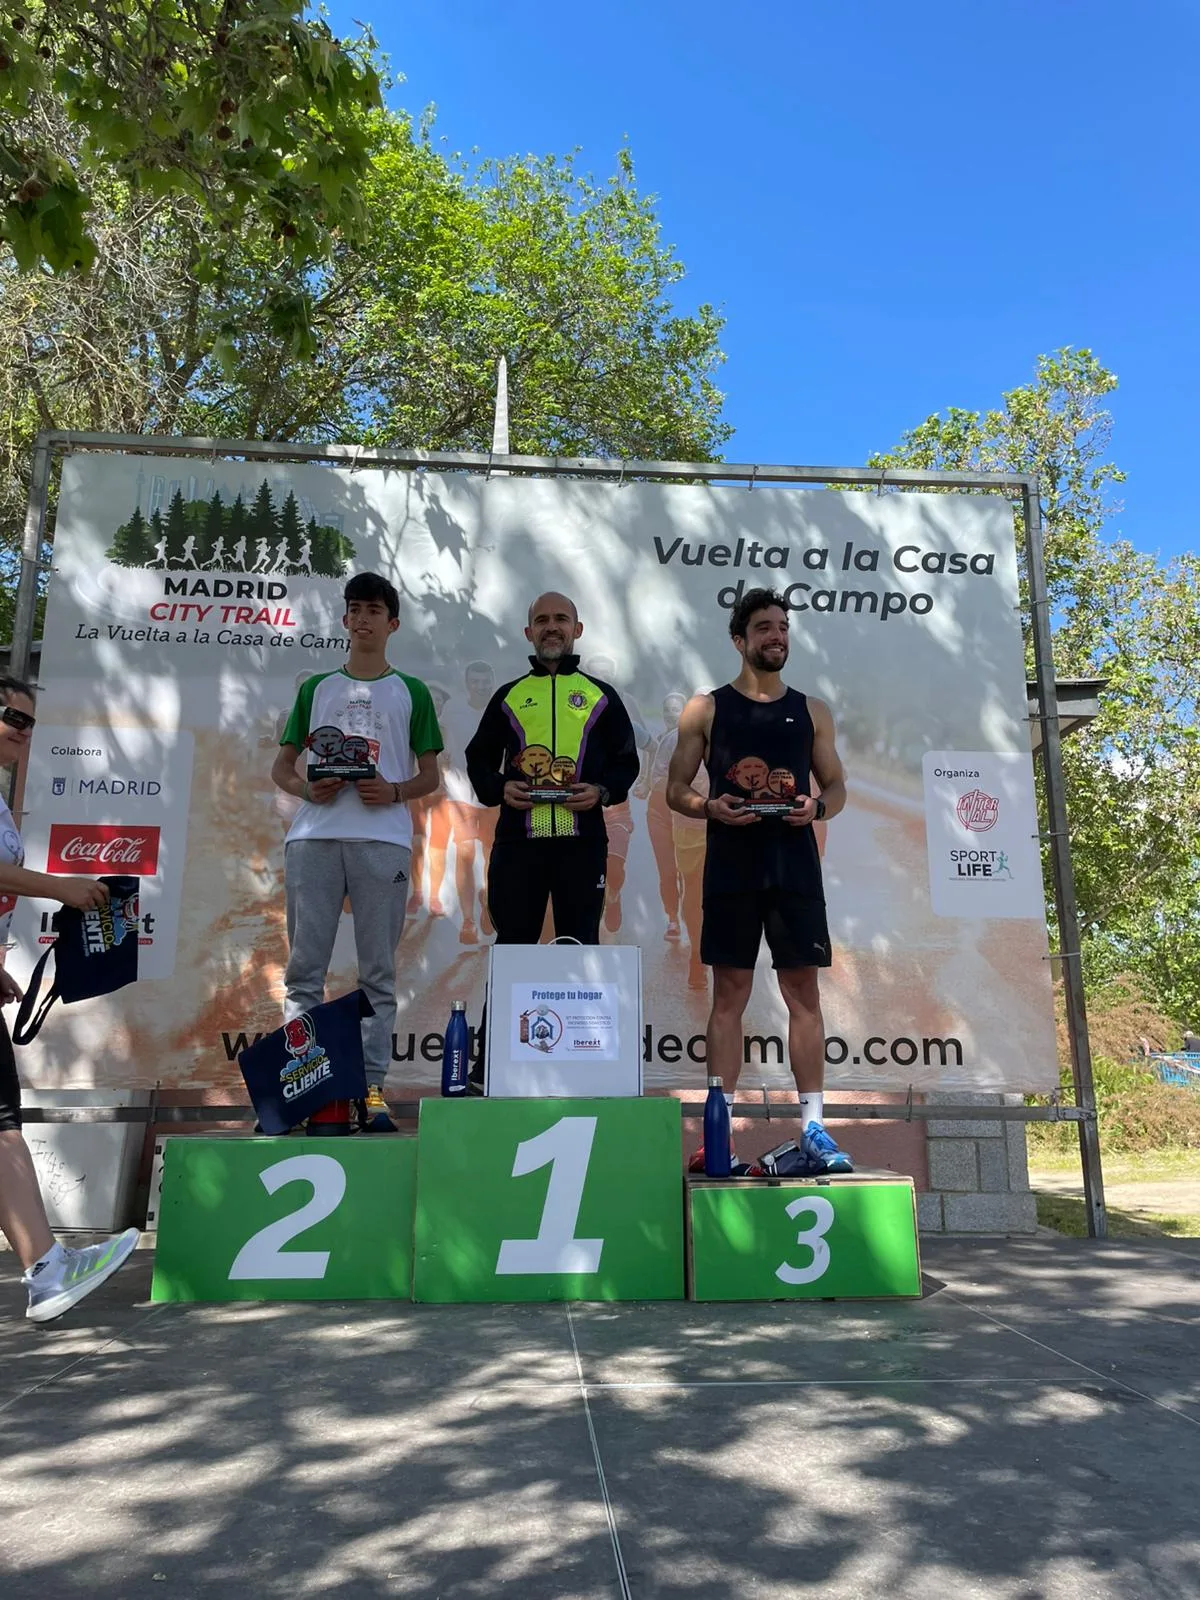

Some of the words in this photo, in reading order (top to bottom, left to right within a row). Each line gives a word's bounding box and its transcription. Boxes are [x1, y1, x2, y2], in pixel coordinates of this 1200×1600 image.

[653, 536, 790, 569] Vuelta
[802, 546, 829, 570] a
[842, 542, 879, 571] la
[893, 545, 995, 575] Casa
[164, 577, 288, 600] MADRID
[150, 602, 212, 623] CITY
[220, 604, 296, 626] TRAIL
[784, 582, 934, 621] Campo
[75, 624, 99, 639] La
[107, 625, 170, 642] Vuelta
[176, 631, 186, 643] a
[193, 628, 210, 645] la
[217, 630, 263, 647] Casa
[270, 631, 294, 648] de
[51, 746, 102, 757] Colabora
[934, 768, 980, 778] Organiza
[78, 780, 161, 796] MADRID
[61, 836, 147, 863] Coca-Cola
[950, 850, 997, 862] SPORT
[958, 864, 992, 877] LIFE
[532, 990, 566, 1001] Protege
[567, 990, 576, 1000] tu
[577, 990, 603, 1001] hogar
[286, 1054, 324, 1082] SERVICIO
[451, 1049, 459, 1081] Iberext
[283, 1060, 331, 1099] CLIENTE
[495, 1116, 604, 1275] 1
[228, 1154, 347, 1280] 2
[775, 1195, 836, 1286] 3
